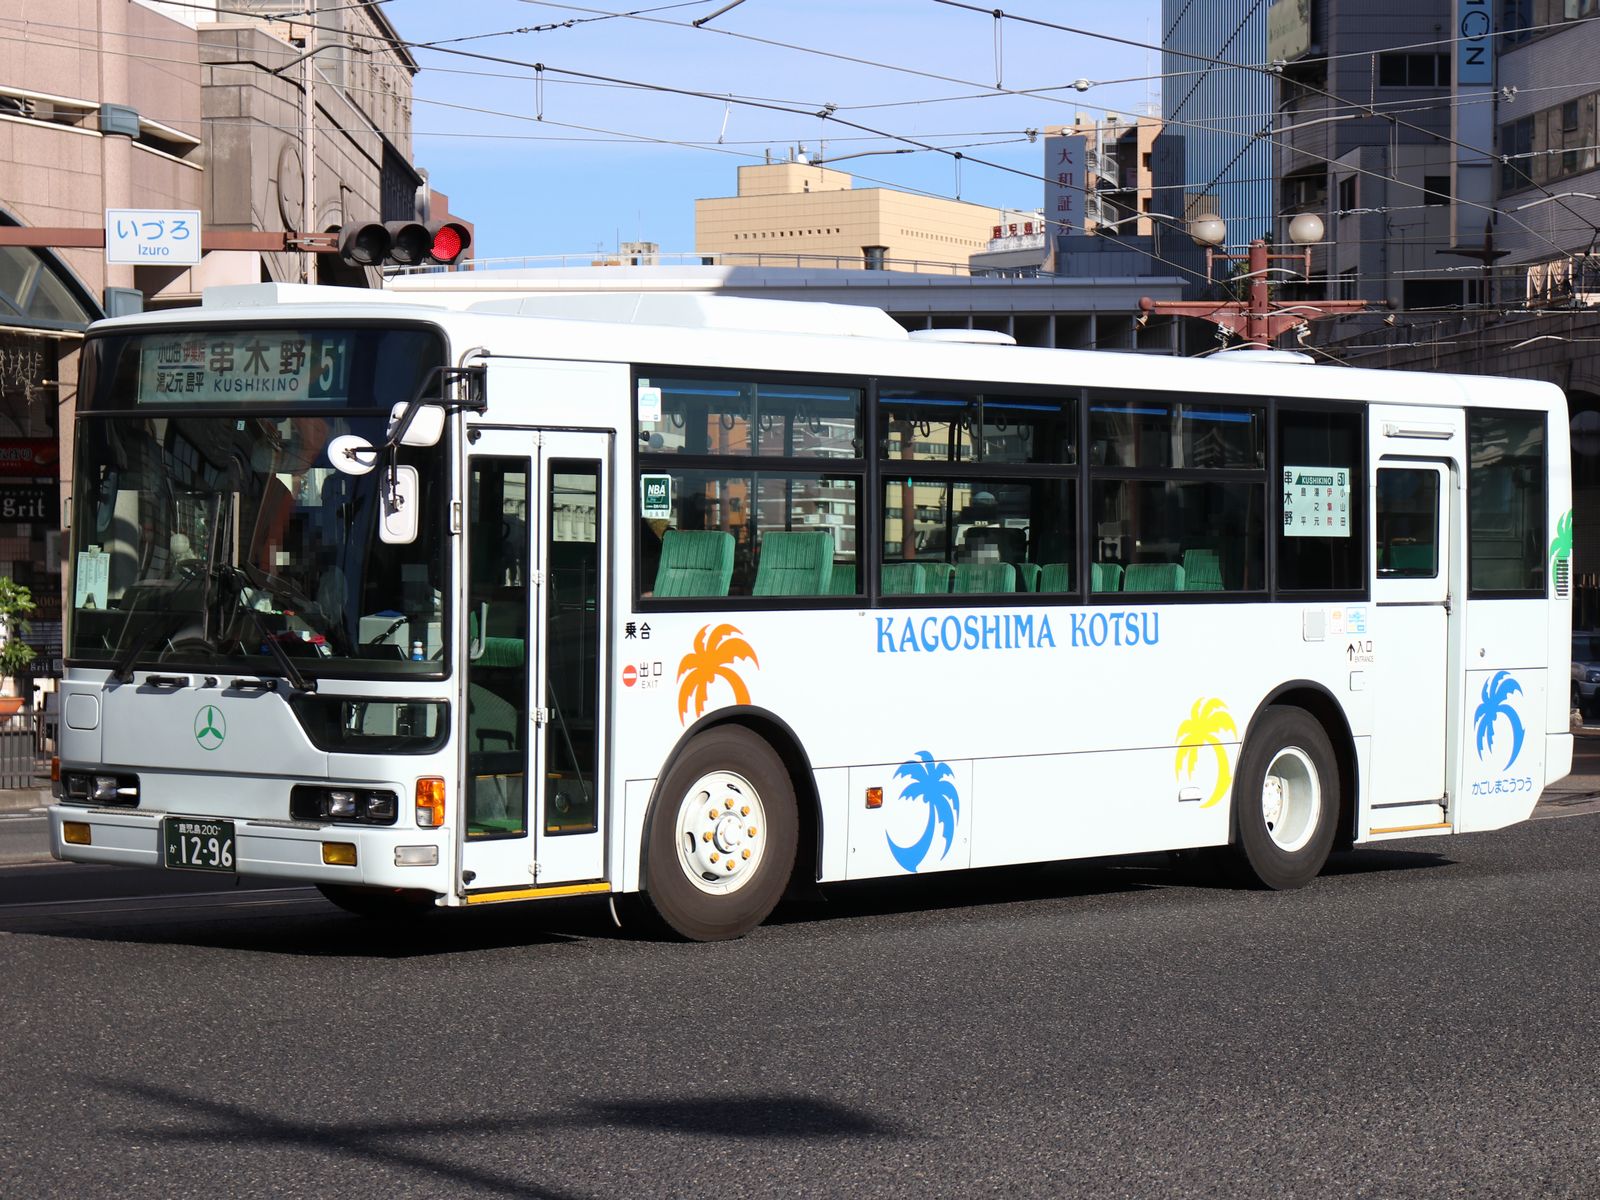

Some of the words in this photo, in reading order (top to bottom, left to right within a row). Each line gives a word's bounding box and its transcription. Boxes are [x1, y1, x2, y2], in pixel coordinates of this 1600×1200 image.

[1057, 147, 1073, 235] 大和証券
[117, 219, 190, 240] いづろ
[138, 244, 170, 256] Izuro
[209, 340, 306, 377] 串木野
[319, 340, 346, 392] 51
[214, 377, 299, 392] KUSHIKINO
[1301, 476, 1332, 486] KUSHIKINO
[1337, 472, 1346, 486] 51
[648, 484, 666, 496] NBA
[1284, 470, 1293, 526] 串木野
[2, 497, 45, 517] grit
[624, 621, 652, 640] 乗合
[874, 614, 1057, 653] KAGOSHIMA
[1069, 610, 1160, 647] KOTSU
[1356, 640, 1373, 653] 入口
[639, 661, 662, 677] 出口
[641, 680, 659, 689] EXIT
[1472, 777, 1532, 795] かごしまこうつう
[169, 844, 178, 854] か
[180, 835, 233, 867] 12-96
